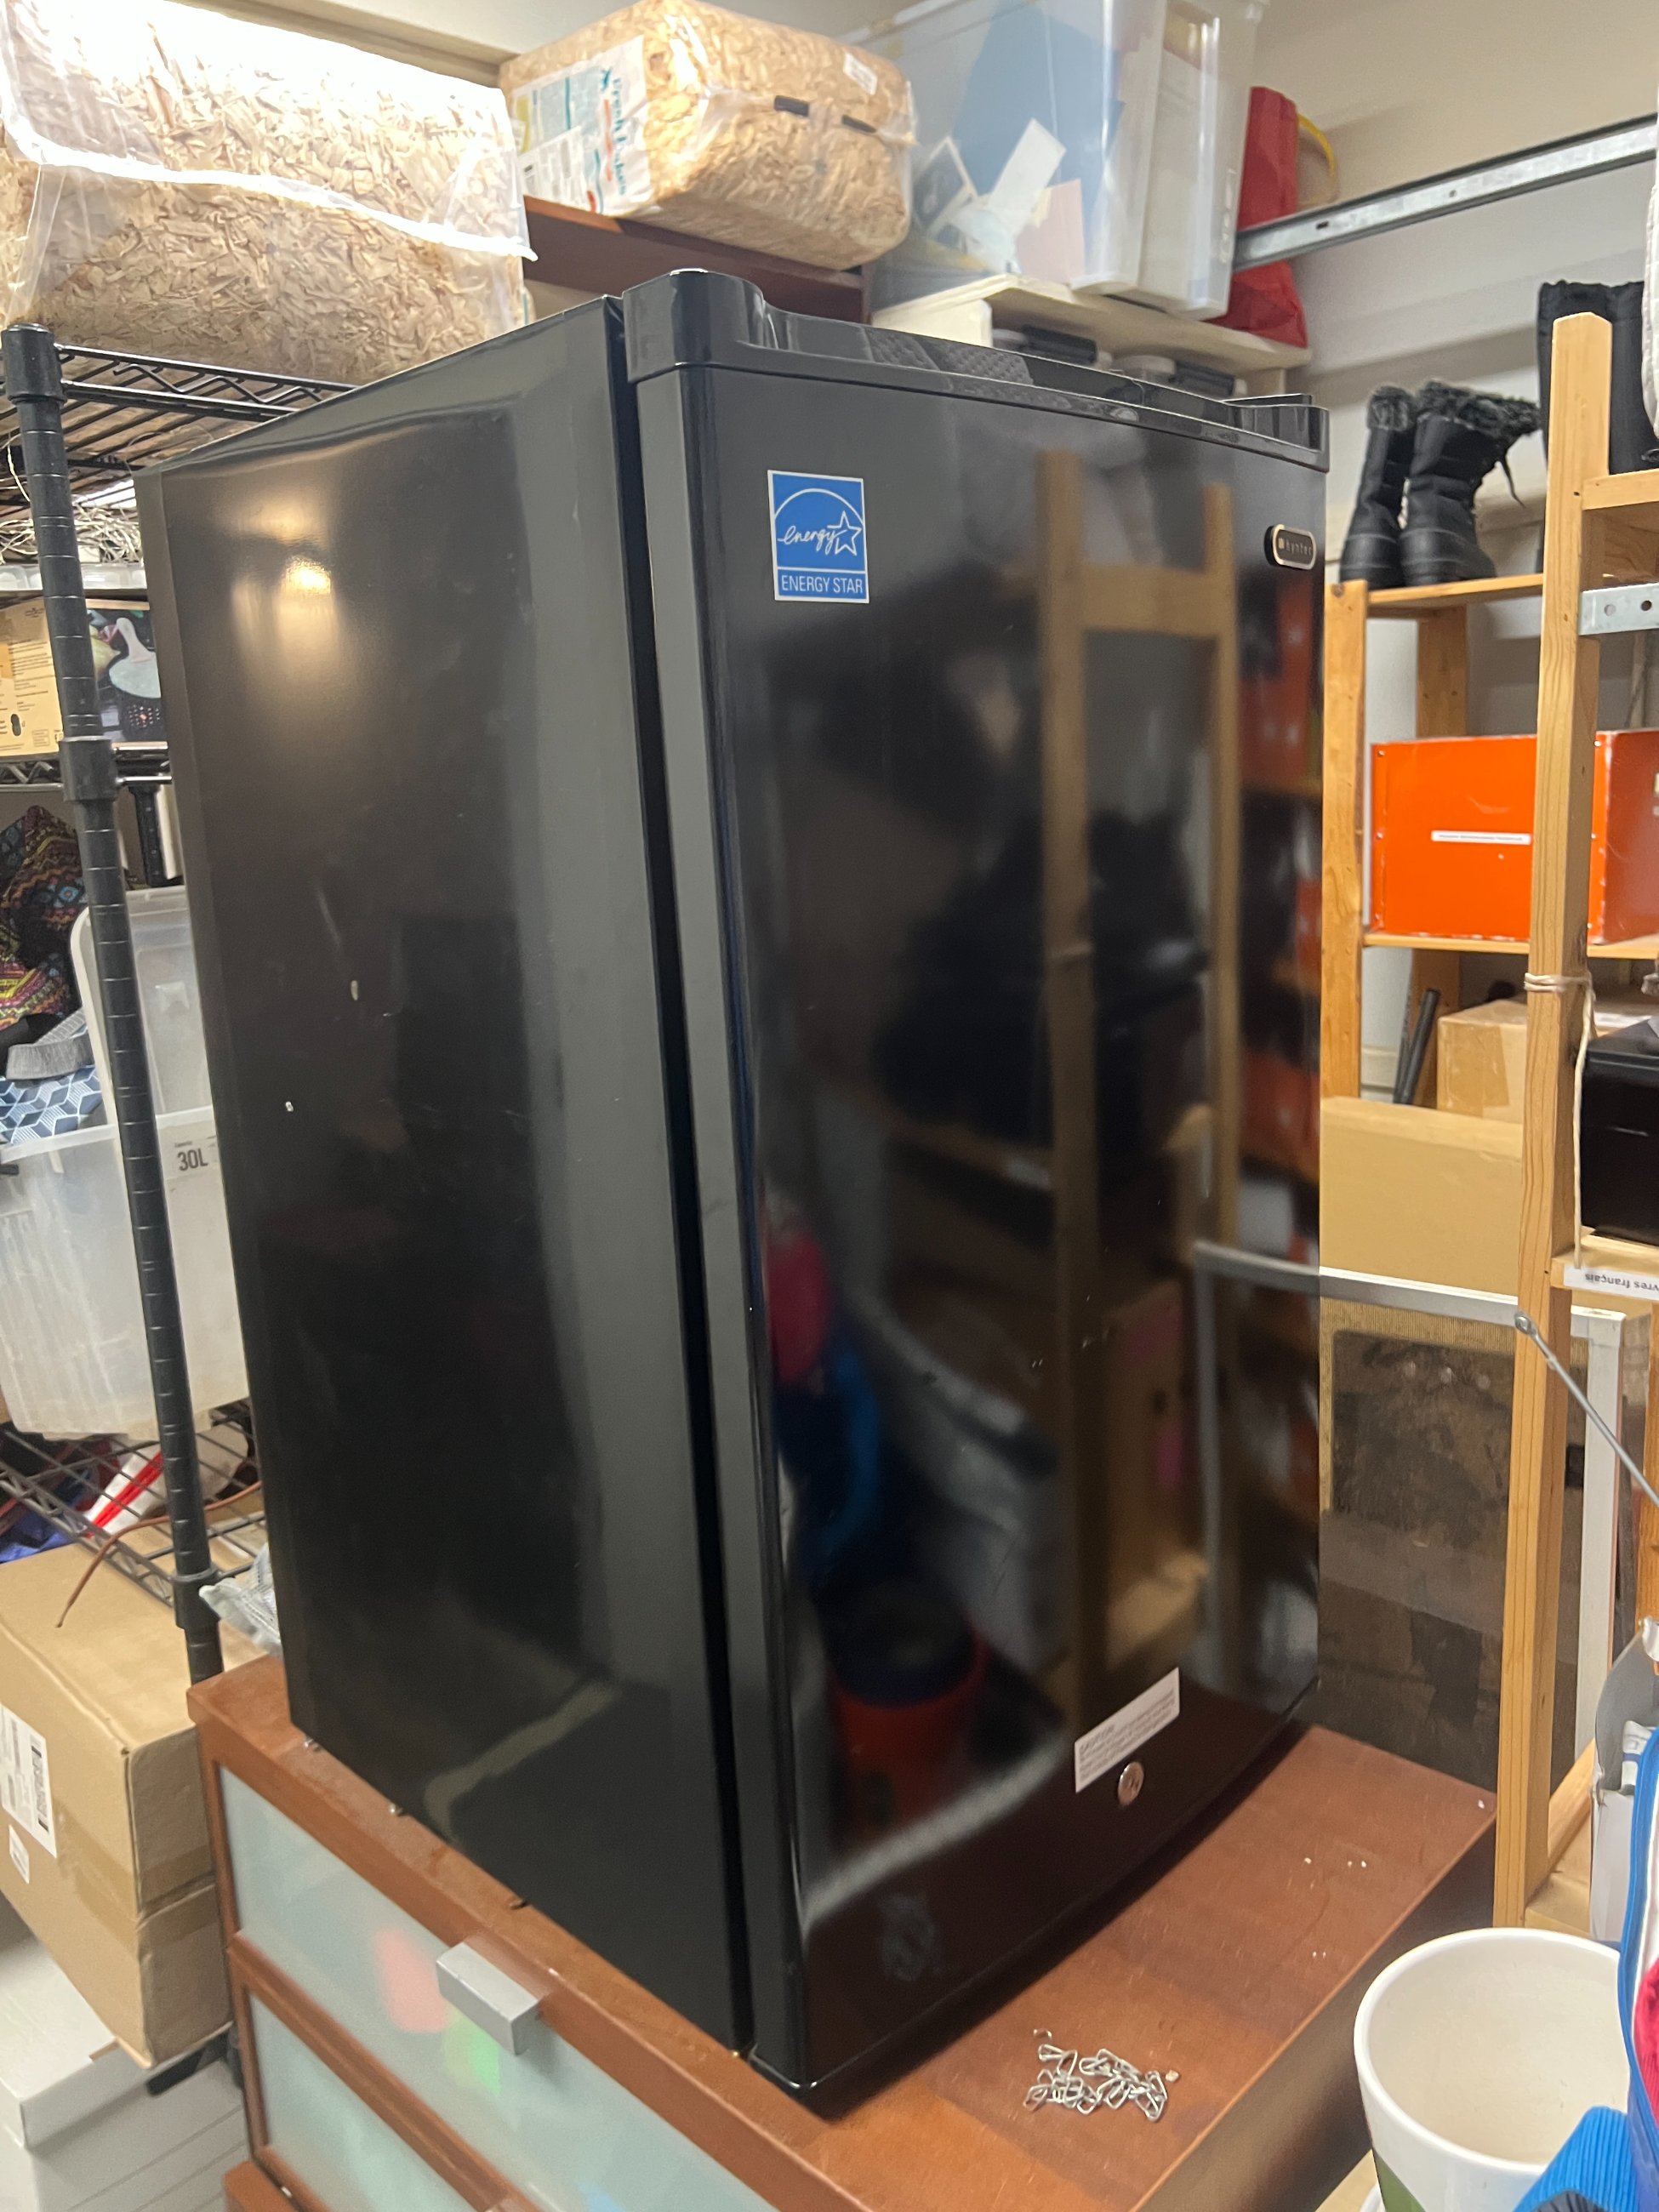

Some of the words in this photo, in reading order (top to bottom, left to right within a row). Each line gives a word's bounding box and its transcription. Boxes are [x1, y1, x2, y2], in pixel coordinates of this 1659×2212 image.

[778, 525, 842, 555] energy
[781, 574, 830, 593] ENERGY
[833, 577, 864, 594] STAR
[177, 1149, 209, 1172] 30L
[1585, 1273, 1630, 1289] français
